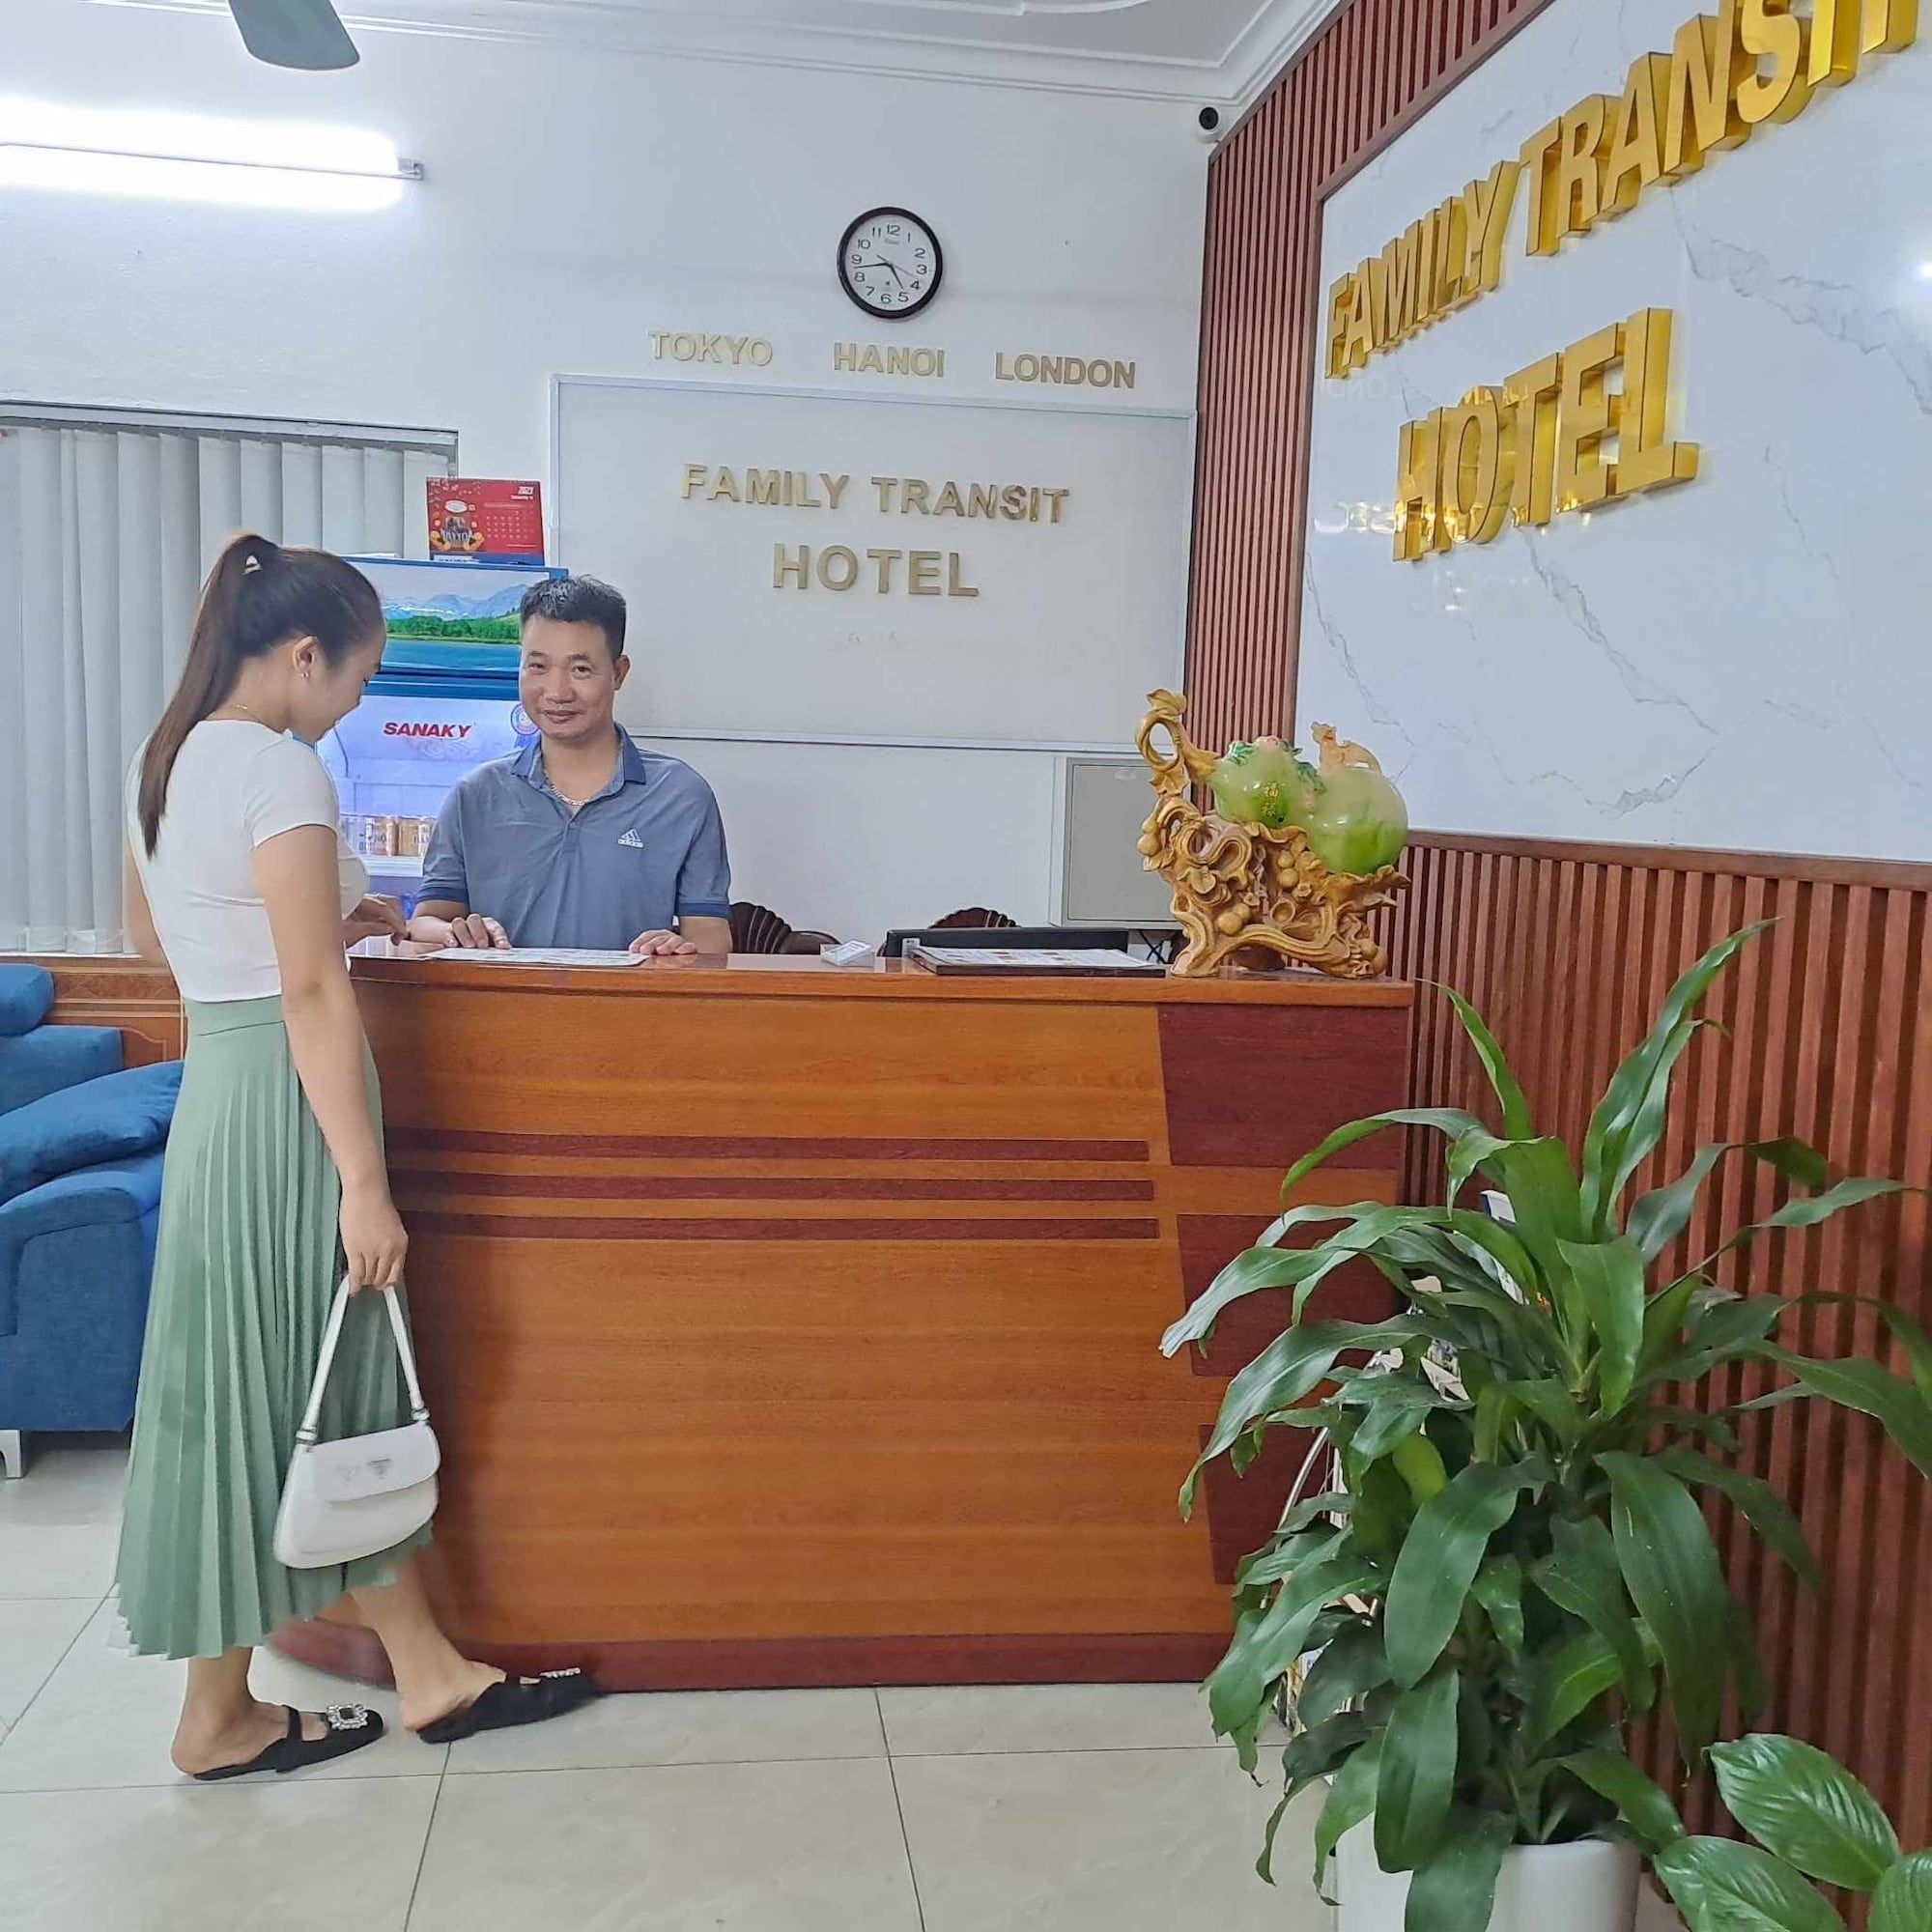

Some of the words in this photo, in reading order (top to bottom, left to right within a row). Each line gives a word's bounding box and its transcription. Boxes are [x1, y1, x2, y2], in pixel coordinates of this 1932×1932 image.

[872, 226, 882, 237] 11
[887, 224, 900, 236] 12
[857, 239, 871, 250] 10
[915, 247, 925, 259] 2
[851, 254, 862, 265] 9
[916, 265, 927, 275] 3
[1324, 159, 1520, 378] FAMILY
[854, 271, 866, 282] 8
[910, 280, 921, 291] 4
[866, 286, 875, 297] 7
[897, 291, 909, 302] 5
[880, 294, 892, 304] 6
[648, 331, 774, 366] TOKYO
[833, 342, 945, 378] HANOI
[995, 353, 1136, 390] LONDON
[1393, 308, 1700, 561] HOTEL
[681, 464, 850, 510] FAMILY
[871, 475, 1069, 524] TRANSIT
[772, 544, 980, 597] HOTEL
[384, 722, 472, 738] SANAKY
